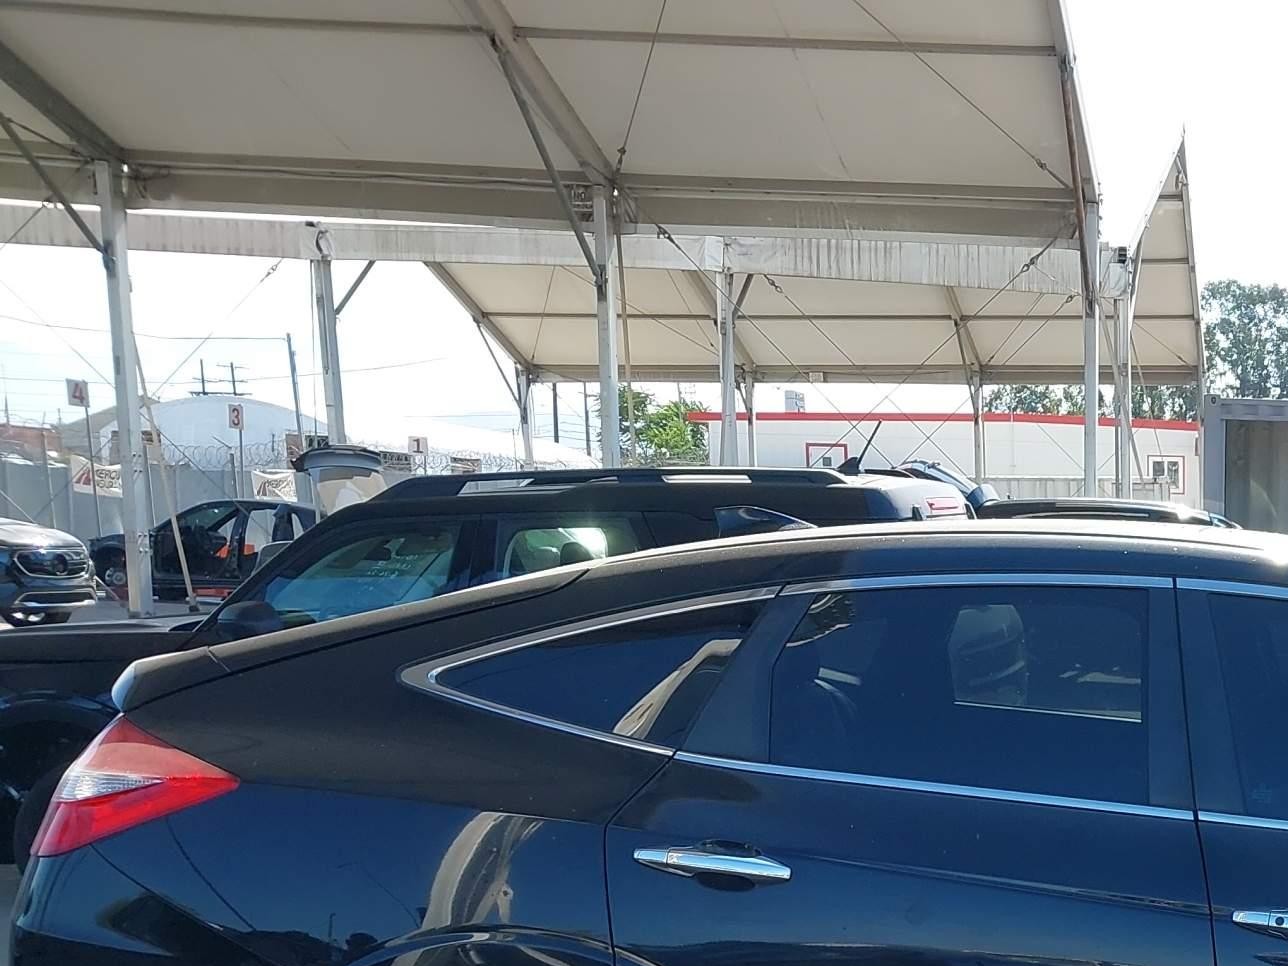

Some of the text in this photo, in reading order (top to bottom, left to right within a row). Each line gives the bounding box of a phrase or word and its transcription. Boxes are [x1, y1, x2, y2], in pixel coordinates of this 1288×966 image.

[72, 383, 85, 405] 4
[231, 407, 241, 427] 3
[412, 438, 424, 454] 1
